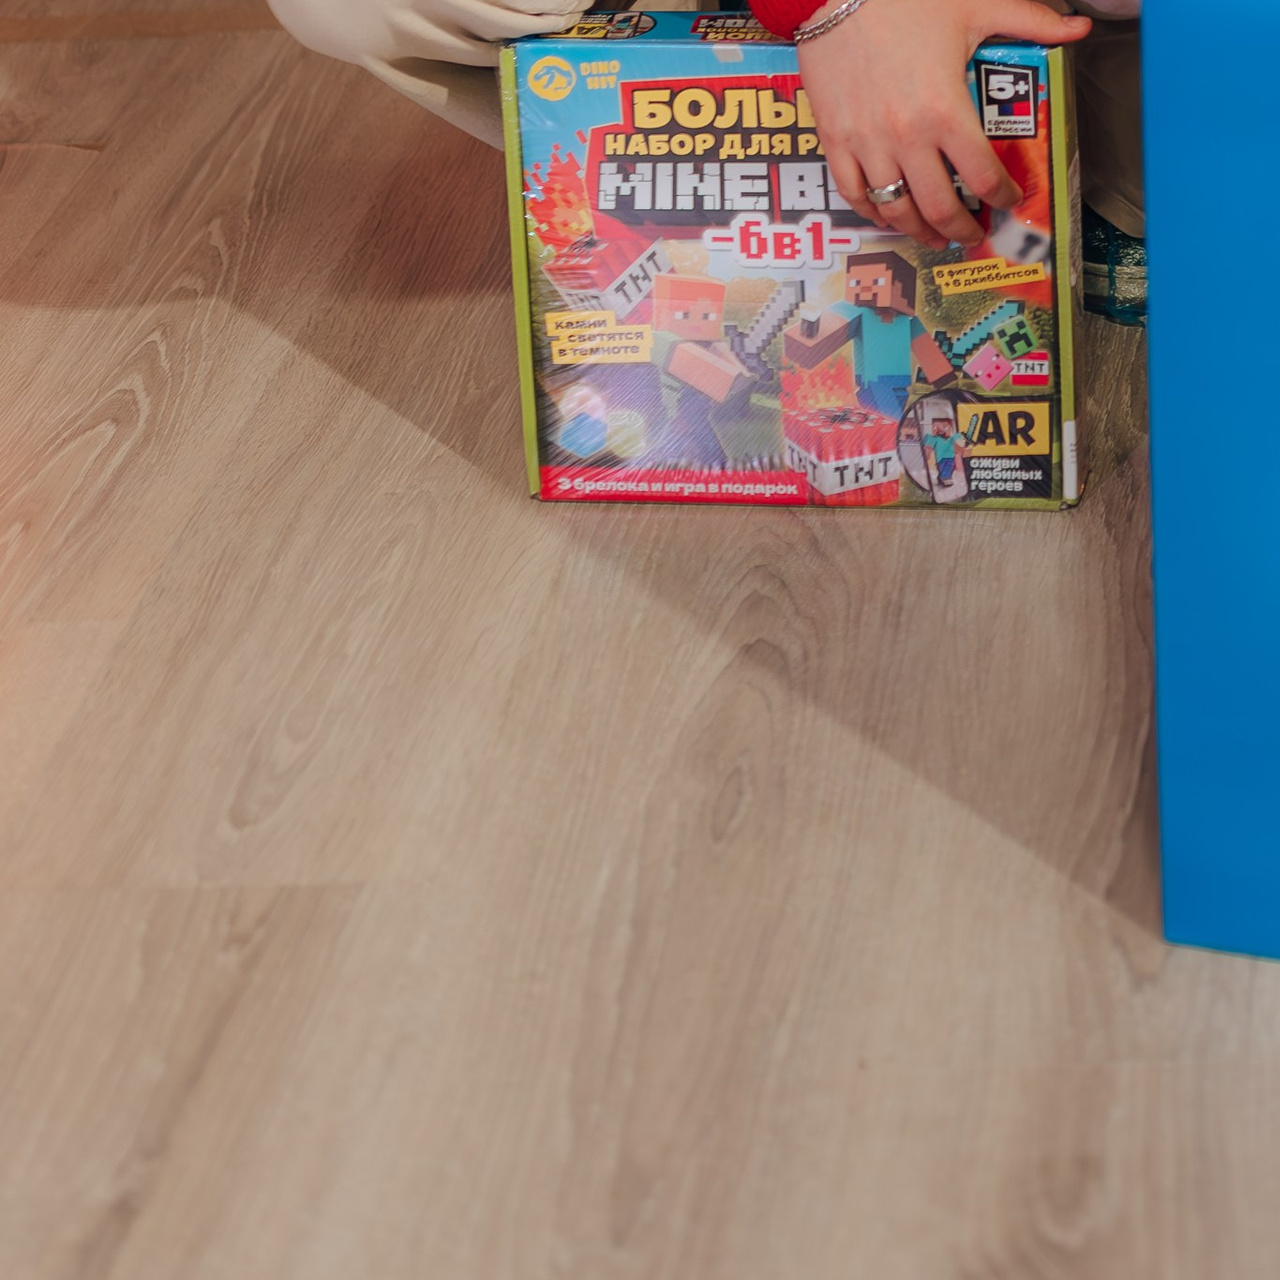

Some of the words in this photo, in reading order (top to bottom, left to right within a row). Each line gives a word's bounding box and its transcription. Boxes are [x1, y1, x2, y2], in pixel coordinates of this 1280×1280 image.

[987, 74, 1029, 100] 5+
[632, 87, 816, 129] БОЛЬ
[604, 133, 716, 156] НАБОР
[718, 133, 792, 160] ДЛЯ
[598, 162, 769, 210] MINE
[947, 263, 999, 279] фигурок
[963, 268, 1039, 288] джиббитсов
[554, 319, 608, 331] камни
[567, 331, 644, 343] светятся
[558, 347, 568, 357] в
[571, 344, 640, 357] темноте
[1016, 362, 1046, 374] TNT
[973, 410, 1036, 447] AR
[834, 456, 892, 487] TNT
[970, 458, 1021, 470] оживи
[970, 469, 1043, 481] любимых
[558, 476, 572, 490] 3
[574, 476, 649, 494] брелока
[650, 480, 662, 491] и
[664, 480, 706, 496] игра
[707, 481, 720, 492] в
[721, 481, 798, 497] подарок
[971, 480, 1023, 493] героев
